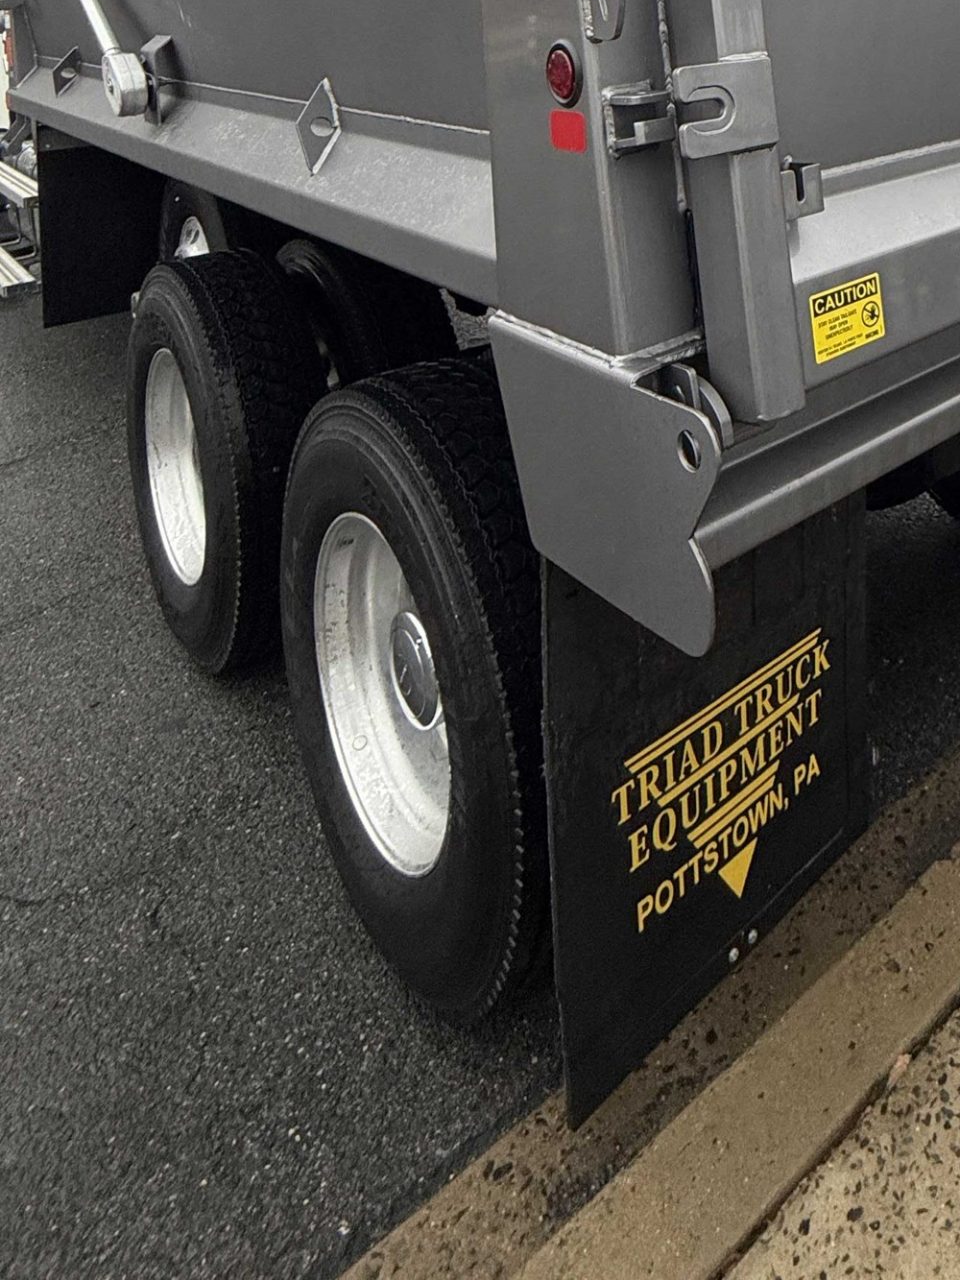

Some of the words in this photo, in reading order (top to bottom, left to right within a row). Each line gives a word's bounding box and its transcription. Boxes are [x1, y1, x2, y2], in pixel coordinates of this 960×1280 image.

[815, 279, 877, 314] CAUTION
[610, 720, 725, 826] TRIAD
[733, 638, 832, 729] TRUCK
[627, 688, 825, 874] EQUIPMENT
[636, 781, 790, 933] POTTSTOWN,
[793, 753, 821, 797] PA
